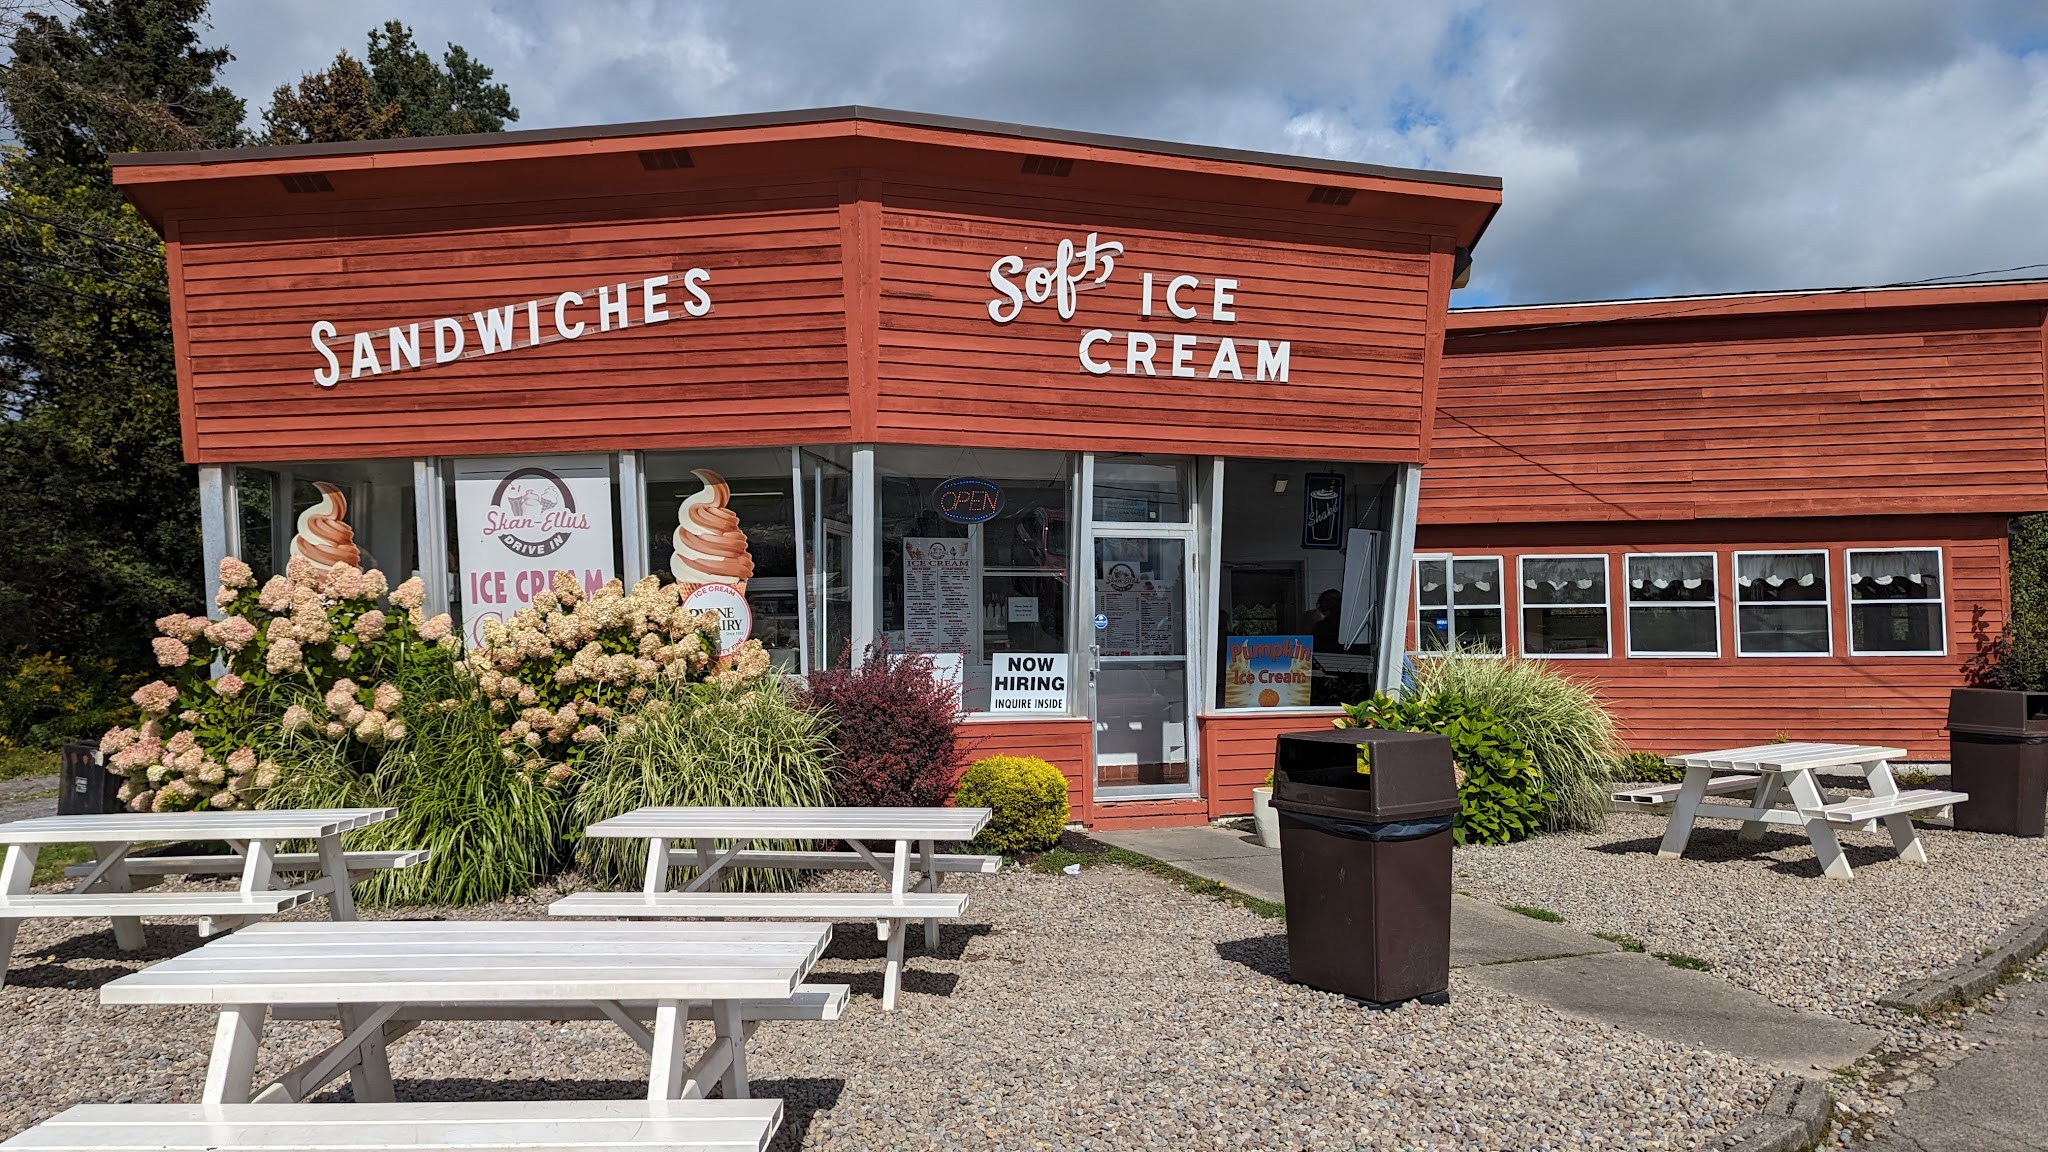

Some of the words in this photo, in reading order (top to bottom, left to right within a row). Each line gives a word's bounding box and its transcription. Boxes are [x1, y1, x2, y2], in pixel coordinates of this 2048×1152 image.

[987, 231, 1124, 323] Soft
[1141, 272, 1238, 322] ICE
[310, 268, 713, 387] SANDWICHES
[1078, 328, 1291, 383] CREAM
[941, 490, 999, 511] OPEN
[482, 510, 591, 536] Skan-Ellus
[1308, 502, 1339, 527] Shake
[503, 535, 545, 555] DRIVE
[549, 534, 564, 550] IN
[470, 571, 507, 605] ICE
[515, 569, 604, 603] CRM
[694, 588, 707, 598] ICE
[708, 586, 735, 596] CREAM
[720, 620, 742, 630] IRY
[732, 638, 743, 650] FINE
[1230, 637, 1312, 664] Pumpkin
[1008, 657, 1055, 672] NOW
[995, 676, 1065, 691] HIRING
[1234, 669, 1255, 685] Ice
[1258, 669, 1307, 684] Cream
[995, 698, 1032, 709] INQUIRE
[1034, 698, 1063, 709] INSIDE
